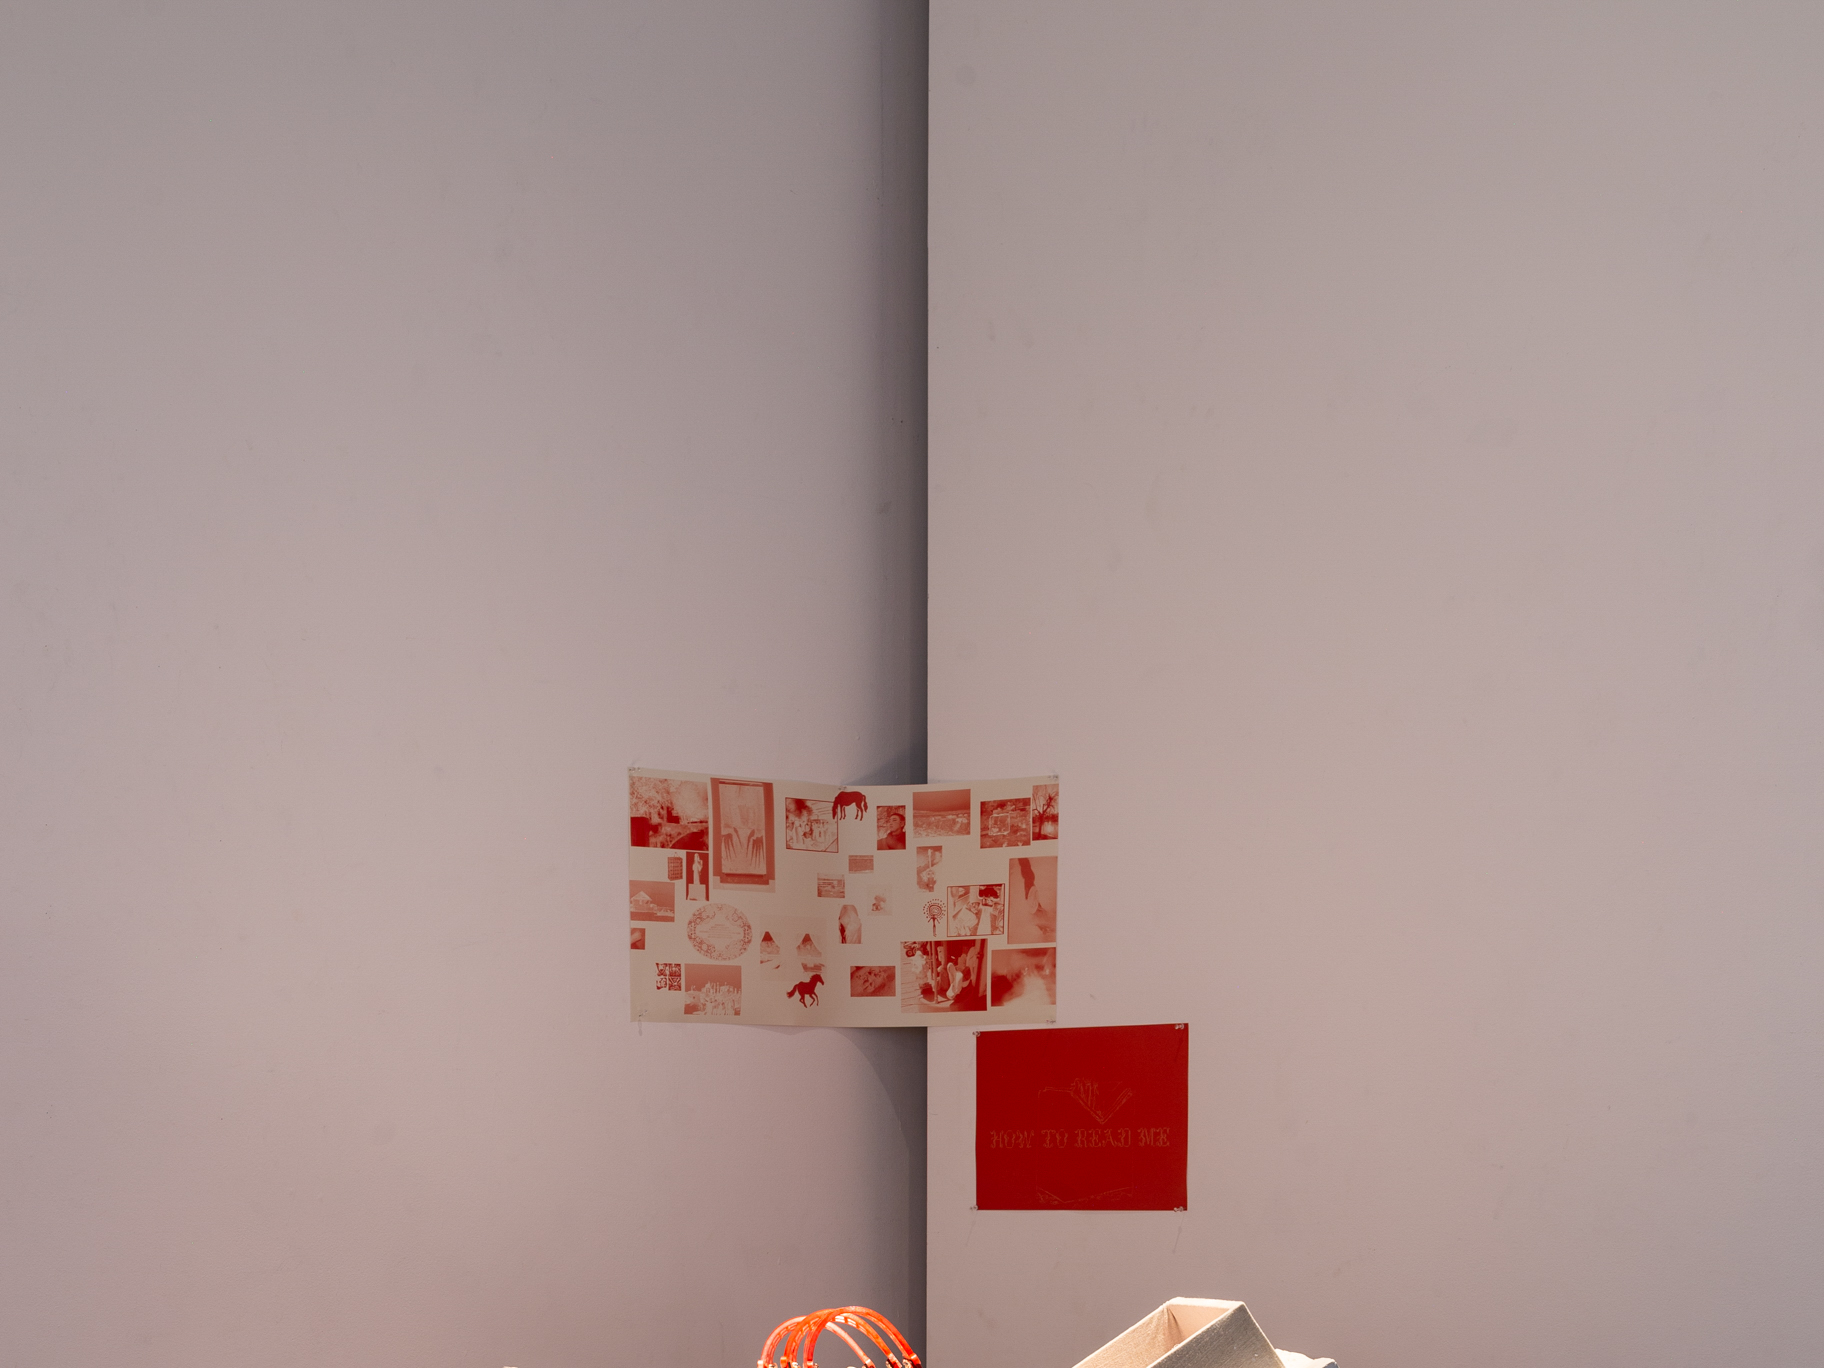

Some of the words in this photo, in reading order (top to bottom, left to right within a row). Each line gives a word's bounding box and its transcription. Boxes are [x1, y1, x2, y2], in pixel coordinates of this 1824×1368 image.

[990, 1129, 1034, 1148] HOW
[1042, 1129, 1068, 1148] TO
[1074, 1128, 1131, 1147] READ
[1137, 1127, 1170, 1146] ME
